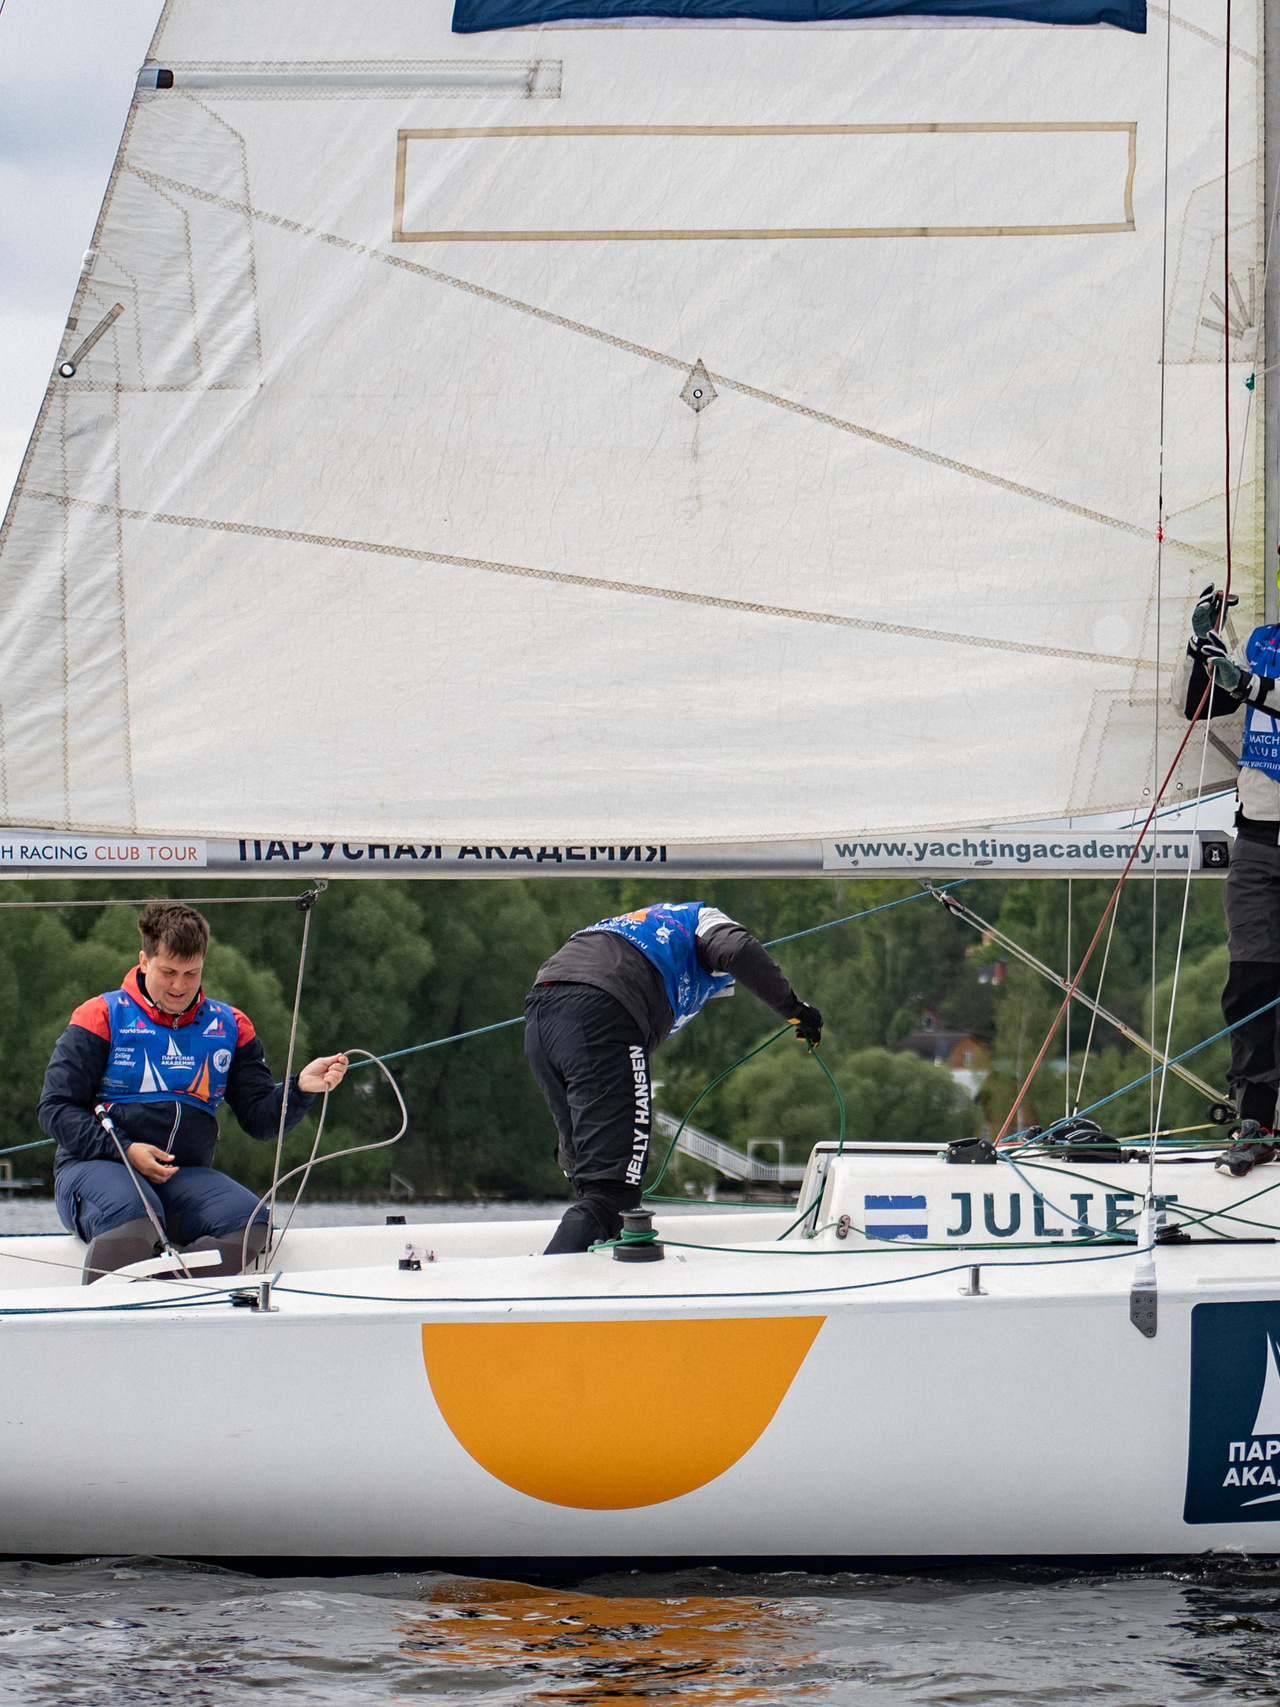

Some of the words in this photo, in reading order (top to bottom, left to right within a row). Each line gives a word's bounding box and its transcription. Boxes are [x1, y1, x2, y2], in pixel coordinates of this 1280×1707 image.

[1249, 734, 1280, 745] MATCH
[20, 845, 88, 860] RACING
[95, 846, 140, 861] CLUB
[147, 846, 198, 861] TOUR
[834, 838, 1190, 864] www.yachtingacademy.ru
[628, 1045, 650, 1125] HANSEN
[625, 1128, 650, 1186] HELLY
